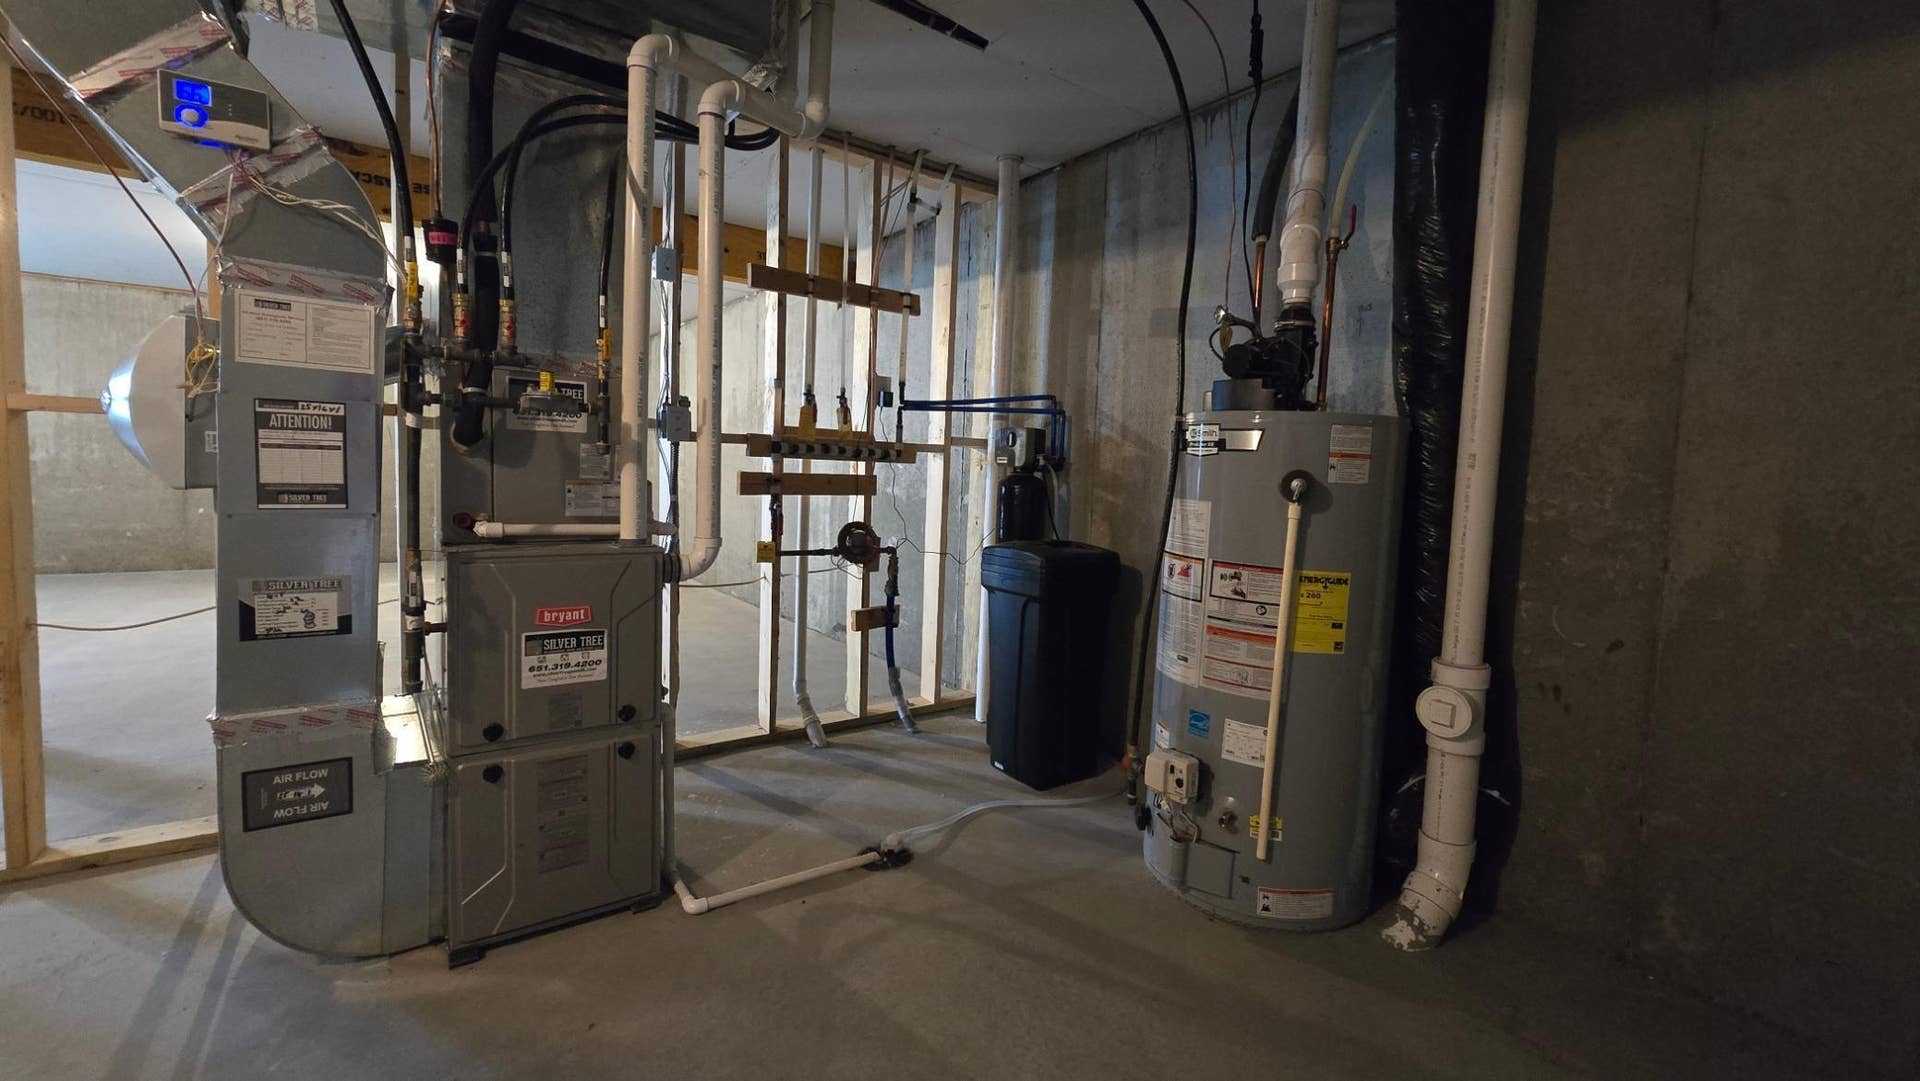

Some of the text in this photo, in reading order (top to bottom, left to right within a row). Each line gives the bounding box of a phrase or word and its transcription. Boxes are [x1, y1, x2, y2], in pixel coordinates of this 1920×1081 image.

[269, 413, 332, 429] ATTENTION!
[268, 579, 340, 590] SILVER TREE
[544, 608, 585, 623] bryant
[544, 637, 577, 650] SILVER
[580, 635, 603, 648] TREE
[528, 659, 602, 673] 651.319.4200
[273, 768, 329, 785] AIR FLOW
[274, 801, 329, 819] AIR FLOW
